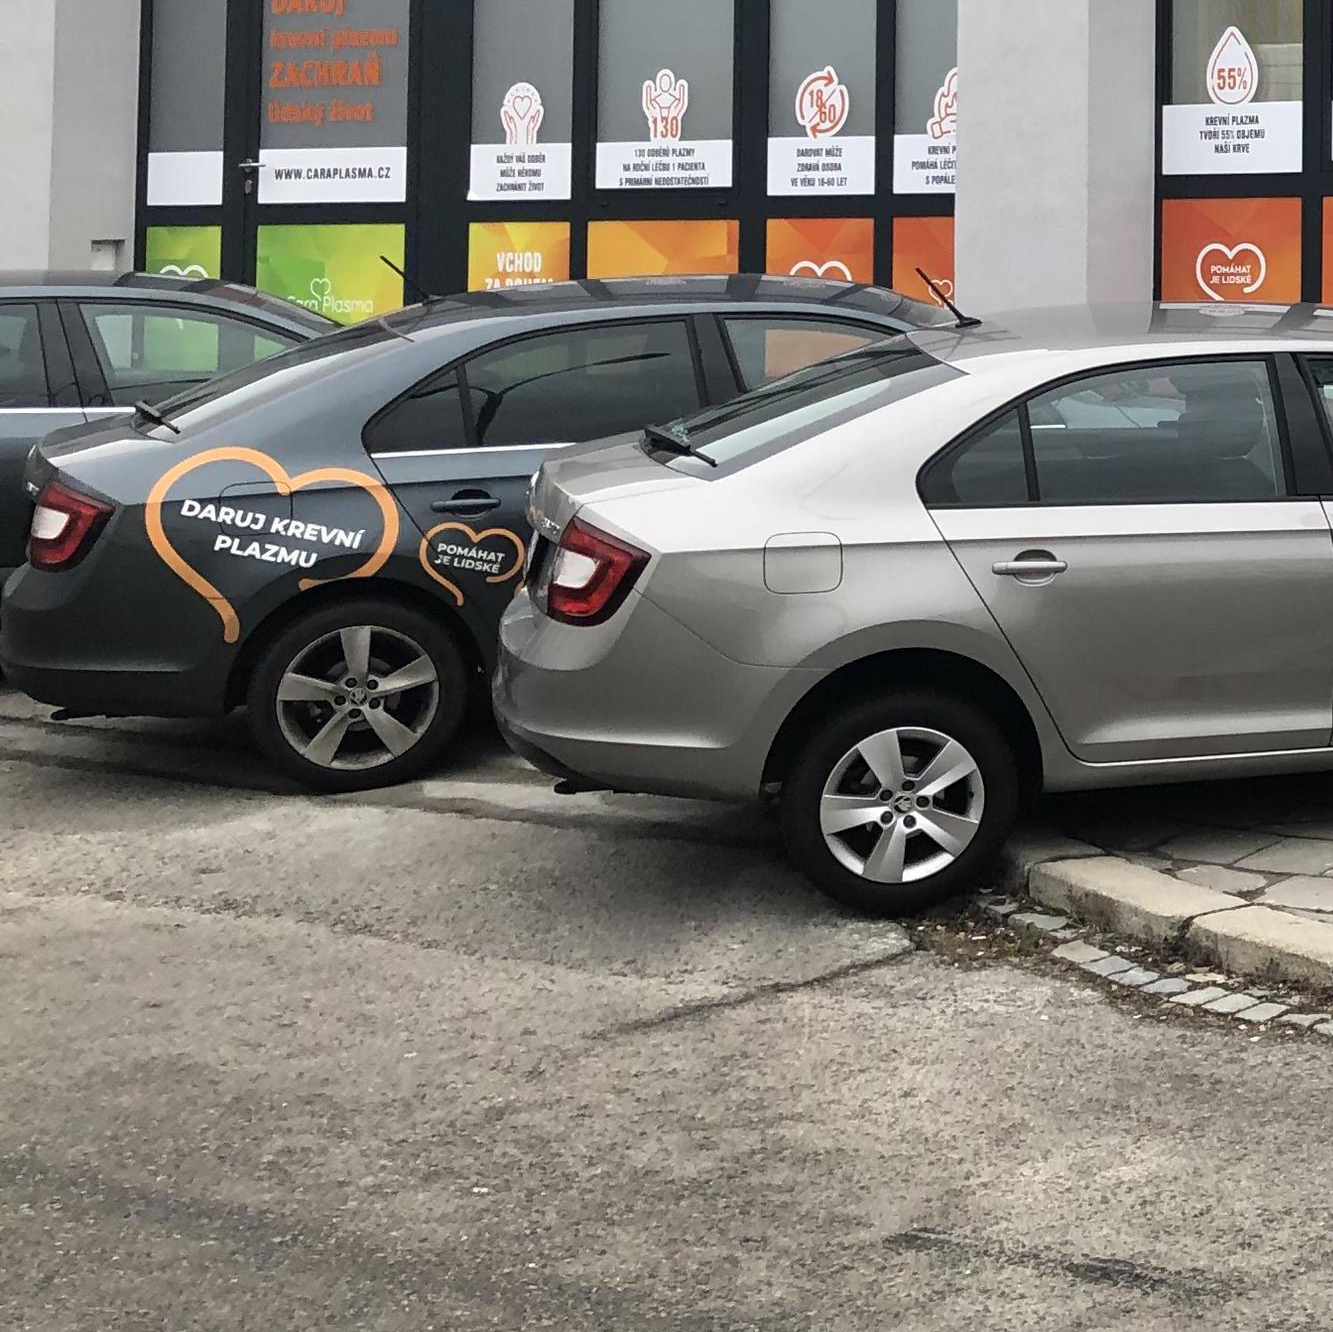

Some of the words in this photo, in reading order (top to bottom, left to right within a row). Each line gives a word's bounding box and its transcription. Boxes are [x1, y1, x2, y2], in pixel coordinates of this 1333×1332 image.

[269, 51, 381, 88] ZACHRAŇ
[1217, 68, 1247, 90] 55%
[652, 116, 679, 138] 130
[1205, 113, 1230, 126] KREVNÍ
[1232, 115, 1259, 125] PLAZMA
[1236, 129, 1265, 139] OBJEMU
[1233, 143, 1250, 153] KRVE
[274, 167, 391, 180] WWW.CARAPLASMA.CZ
[836, 177, 847, 186] LET
[496, 251, 542, 273] VCHOD
[1210, 263, 1252, 274] POMÁHAT
[1209, 276, 1220, 284] JE
[1222, 274, 1252, 284] LIDSKÉ
[322, 296, 374, 313] Plasma
[180, 500, 267, 531] DARUJ
[270, 517, 366, 550] KREVNÍ
[213, 535, 318, 569] PLAZMU
[437, 543, 505, 562] POMÁHAT
[434, 555, 450, 565] JE
[453, 557, 501, 573] LIDSKÉ
